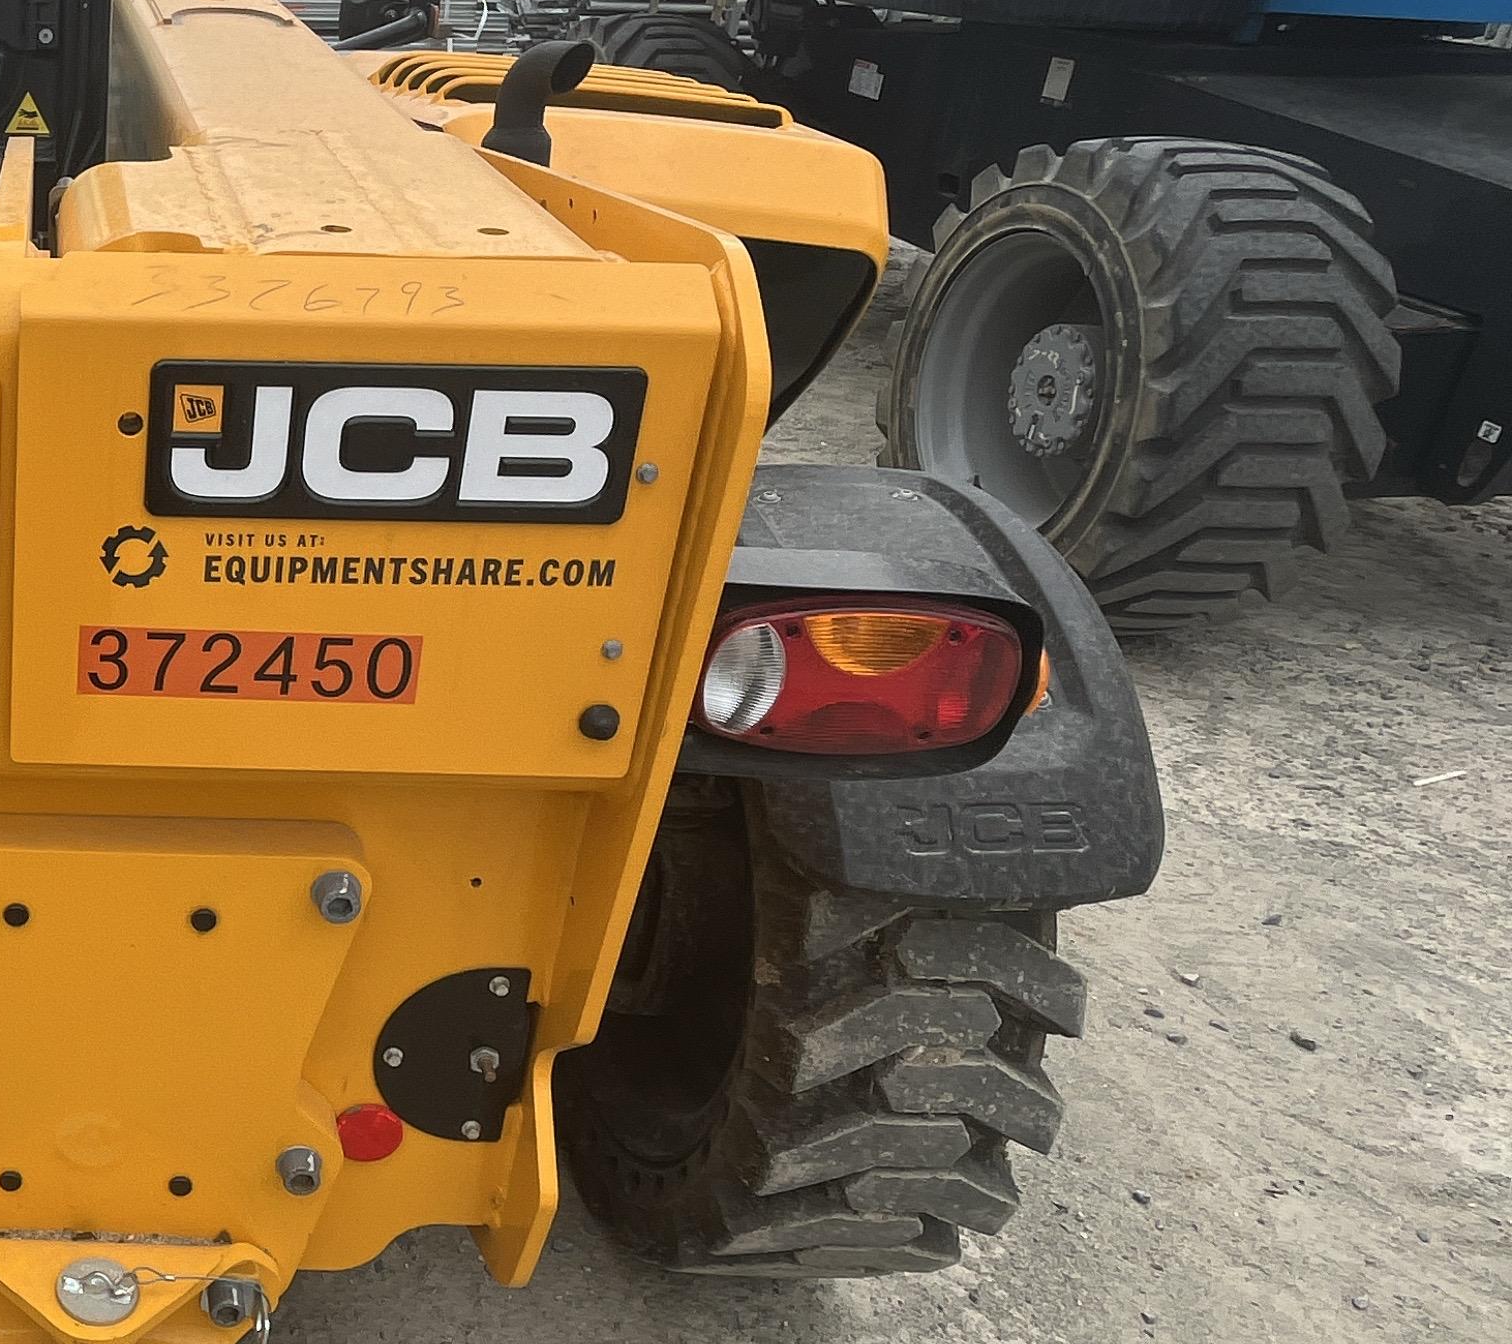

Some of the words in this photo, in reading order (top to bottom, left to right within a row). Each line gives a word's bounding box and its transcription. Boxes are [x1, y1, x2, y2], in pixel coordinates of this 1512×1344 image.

[180, 393, 217, 423] JCB
[169, 385, 616, 507] JCB
[205, 533, 255, 547] VISIT
[264, 534, 287, 548] US
[296, 535, 325, 548] AT:
[203, 555, 617, 588] EQUIPMENTSHARE.COM
[88, 629, 414, 700] 372450
[895, 802, 1091, 857] JCB
